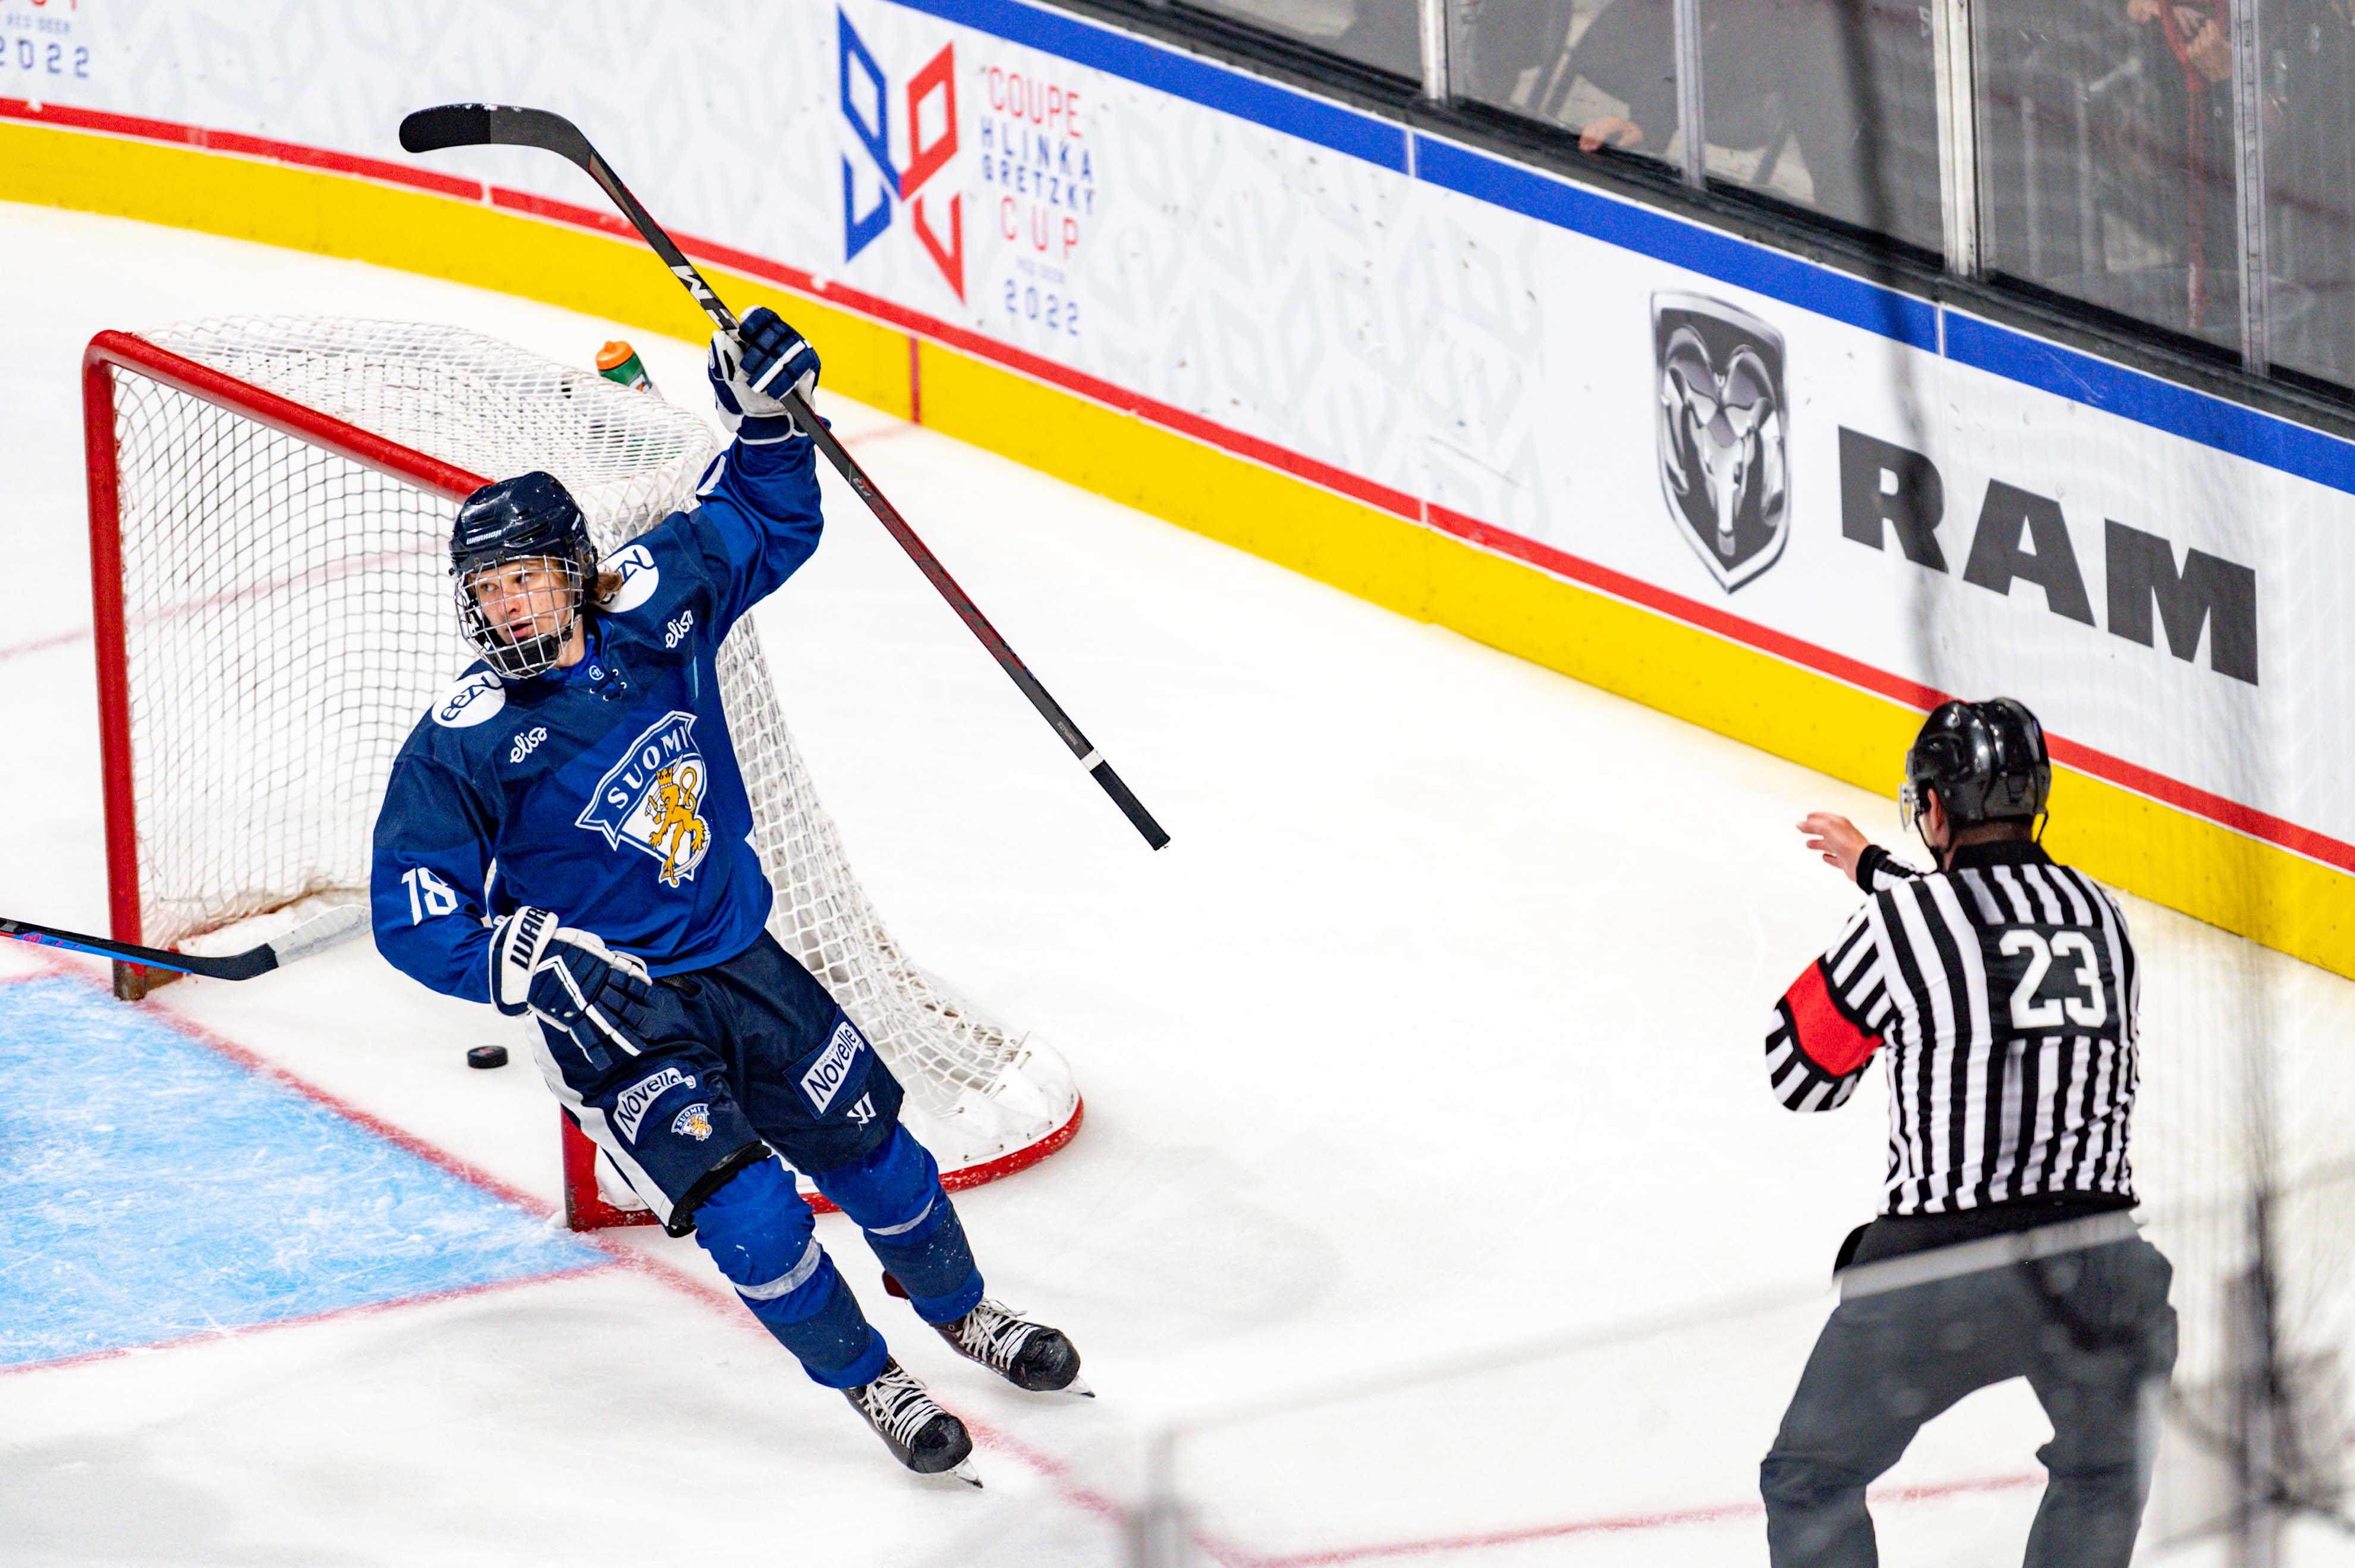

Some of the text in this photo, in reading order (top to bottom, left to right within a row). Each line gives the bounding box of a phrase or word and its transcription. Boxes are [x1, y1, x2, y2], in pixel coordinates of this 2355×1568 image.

[989, 67, 1082, 138] COUPE
[981, 115, 1094, 182] HLINKA
[983, 153, 1094, 215] GRETZKY
[1001, 196, 1079, 259] CUP
[1005, 278, 1079, 336] 2022
[1838, 425, 2258, 685] RAM
[665, 610, 694, 648] elisa
[510, 726, 548, 763] elisa
[607, 726, 689, 809] SUOMI
[401, 867, 458, 925] 18
[510, 908, 549, 971] WAR
[1999, 929, 2108, 1029] 23
[807, 1029, 856, 1104] Novelle
[677, 1106, 702, 1128] SUOMI
